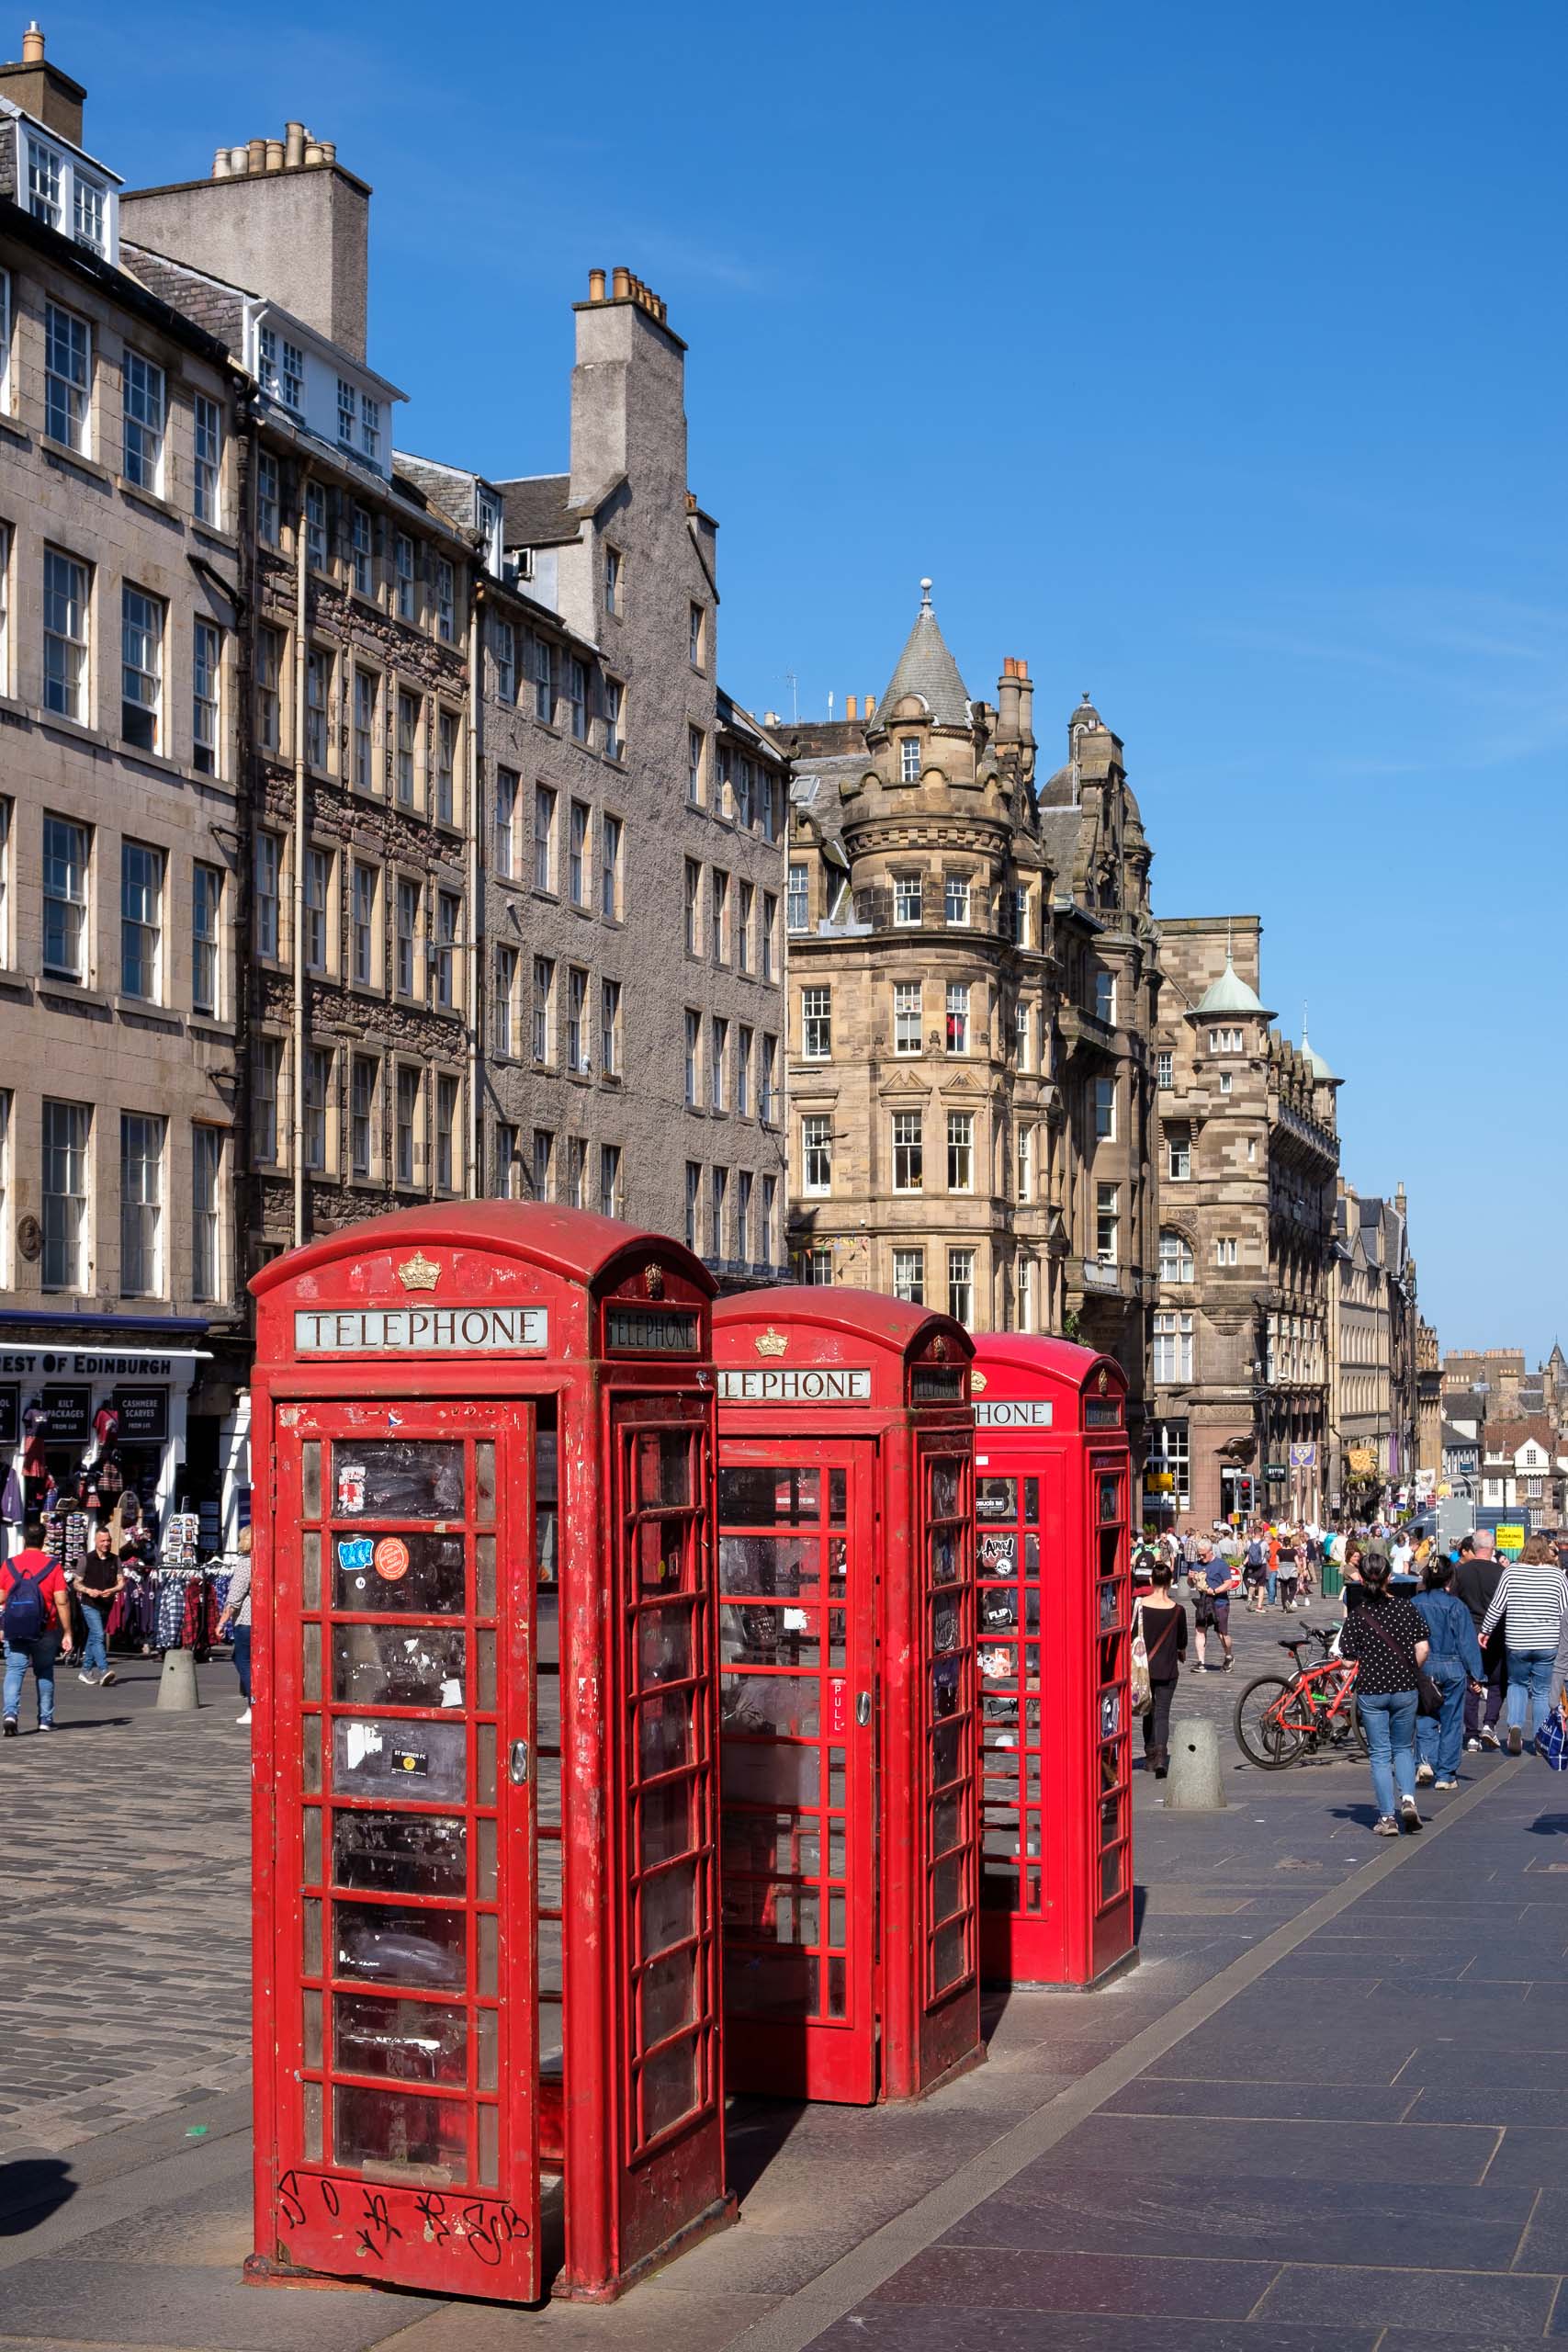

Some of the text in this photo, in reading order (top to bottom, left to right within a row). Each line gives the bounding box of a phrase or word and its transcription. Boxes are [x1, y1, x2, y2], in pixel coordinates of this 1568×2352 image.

[307, 1312, 538, 1346] TELEPHONE
[0, 1355, 36, 1372] EST
[718, 1373, 863, 1397] LEPHONE
[58, 1399, 74, 1408] KILT
[122, 1399, 158, 1408] CASHMERE
[47, 1409, 85, 1419] PACKAGES
[125, 1409, 154, 1418] SCARVES
[988, 1608, 1010, 1620] FLIP
